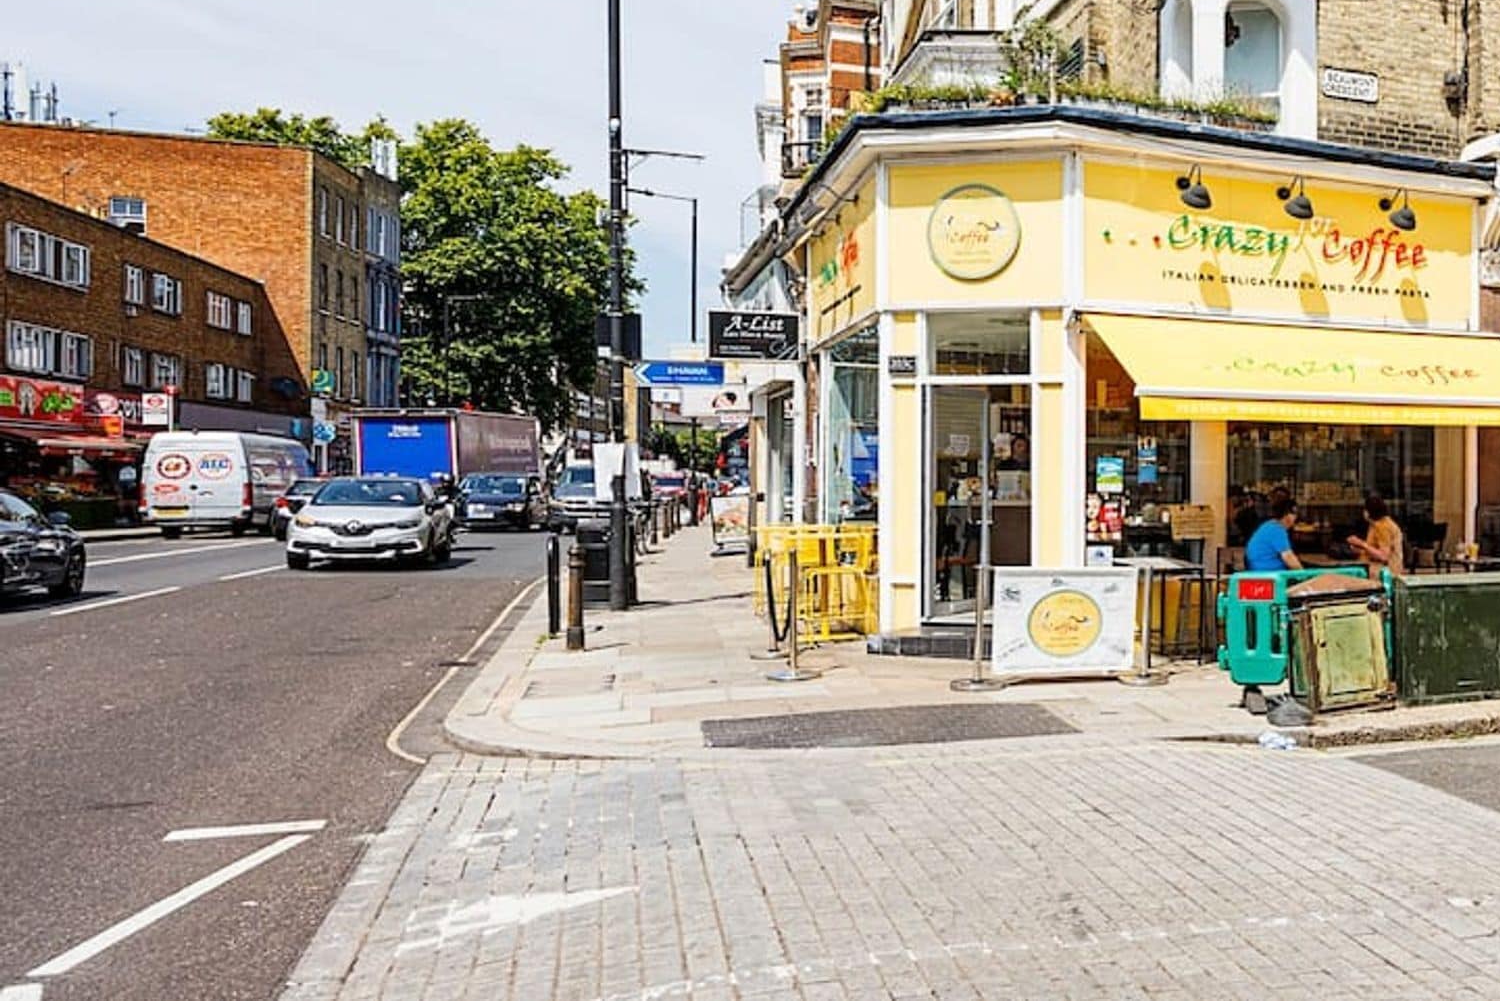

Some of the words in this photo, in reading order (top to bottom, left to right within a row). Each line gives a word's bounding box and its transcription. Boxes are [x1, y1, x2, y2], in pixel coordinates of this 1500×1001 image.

[1323, 228, 1426, 284] Coffee
[1162, 270, 1215, 282] ITALIAN
[1221, 275, 1315, 290] DELICATESSEN
[1322, 283, 1345, 293] AND
[1351, 285, 1389, 295] FRESH
[1395, 288, 1430, 299] PASTA
[723, 314, 785, 332] A-List
